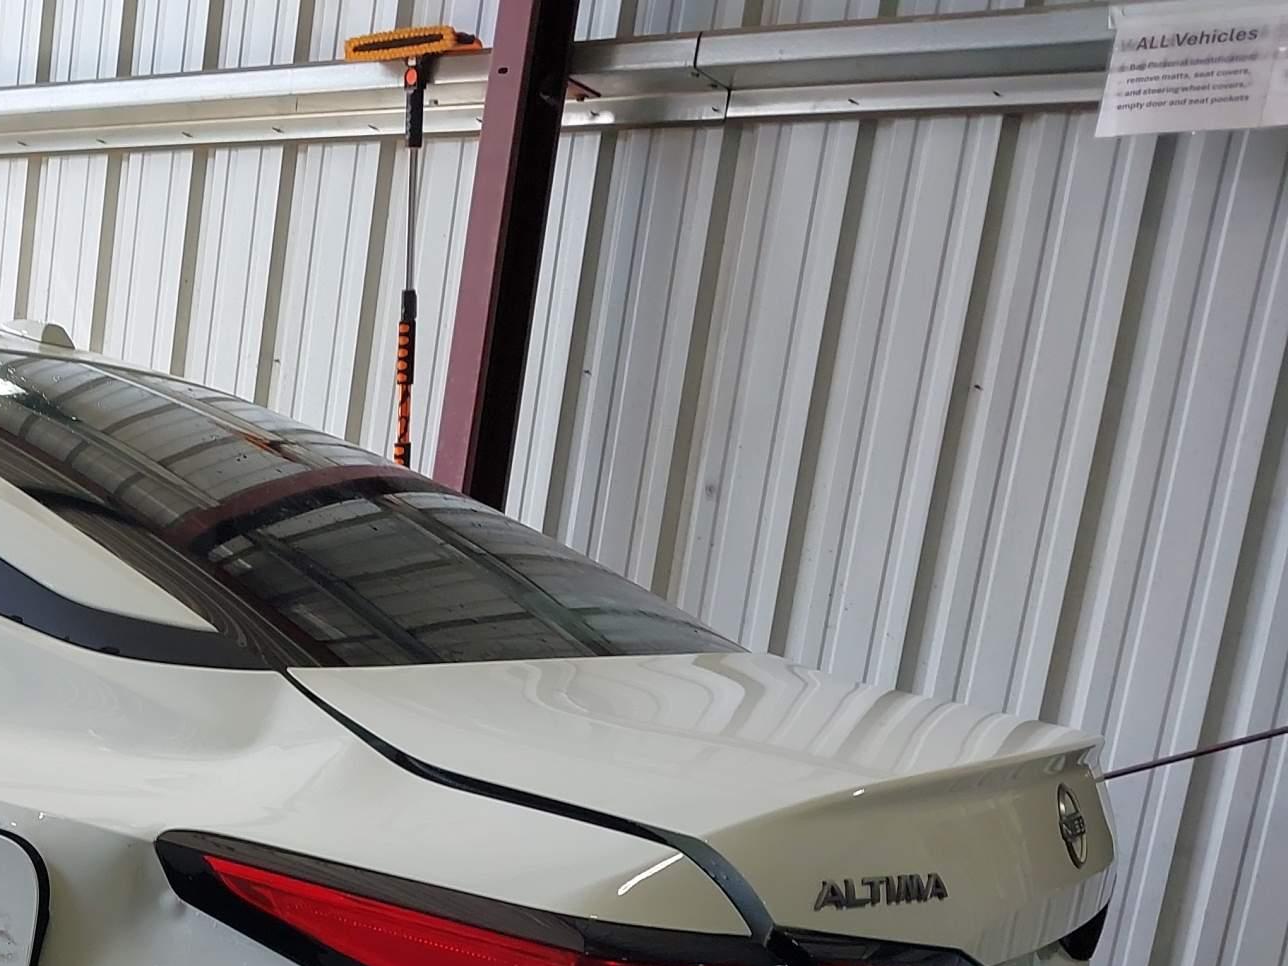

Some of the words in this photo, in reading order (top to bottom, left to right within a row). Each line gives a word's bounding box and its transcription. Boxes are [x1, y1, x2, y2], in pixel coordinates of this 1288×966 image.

[1136, 35, 1169, 51] ALL
[1176, 28, 1258, 46] Vehicles
[1126, 75, 1159, 84] remove
[1194, 70, 1214, 78] seat
[1124, 88, 1141, 97] and
[1143, 85, 1179, 96] steering
[1179, 84, 1210, 93] wheel
[1117, 101, 1144, 112] empty
[1146, 99, 1167, 108] door
[1169, 98, 1186, 107] and
[1188, 96, 1209, 105] seat
[1210, 94, 1249, 104] pockets
[814, 873, 948, 911] ALTIMA
